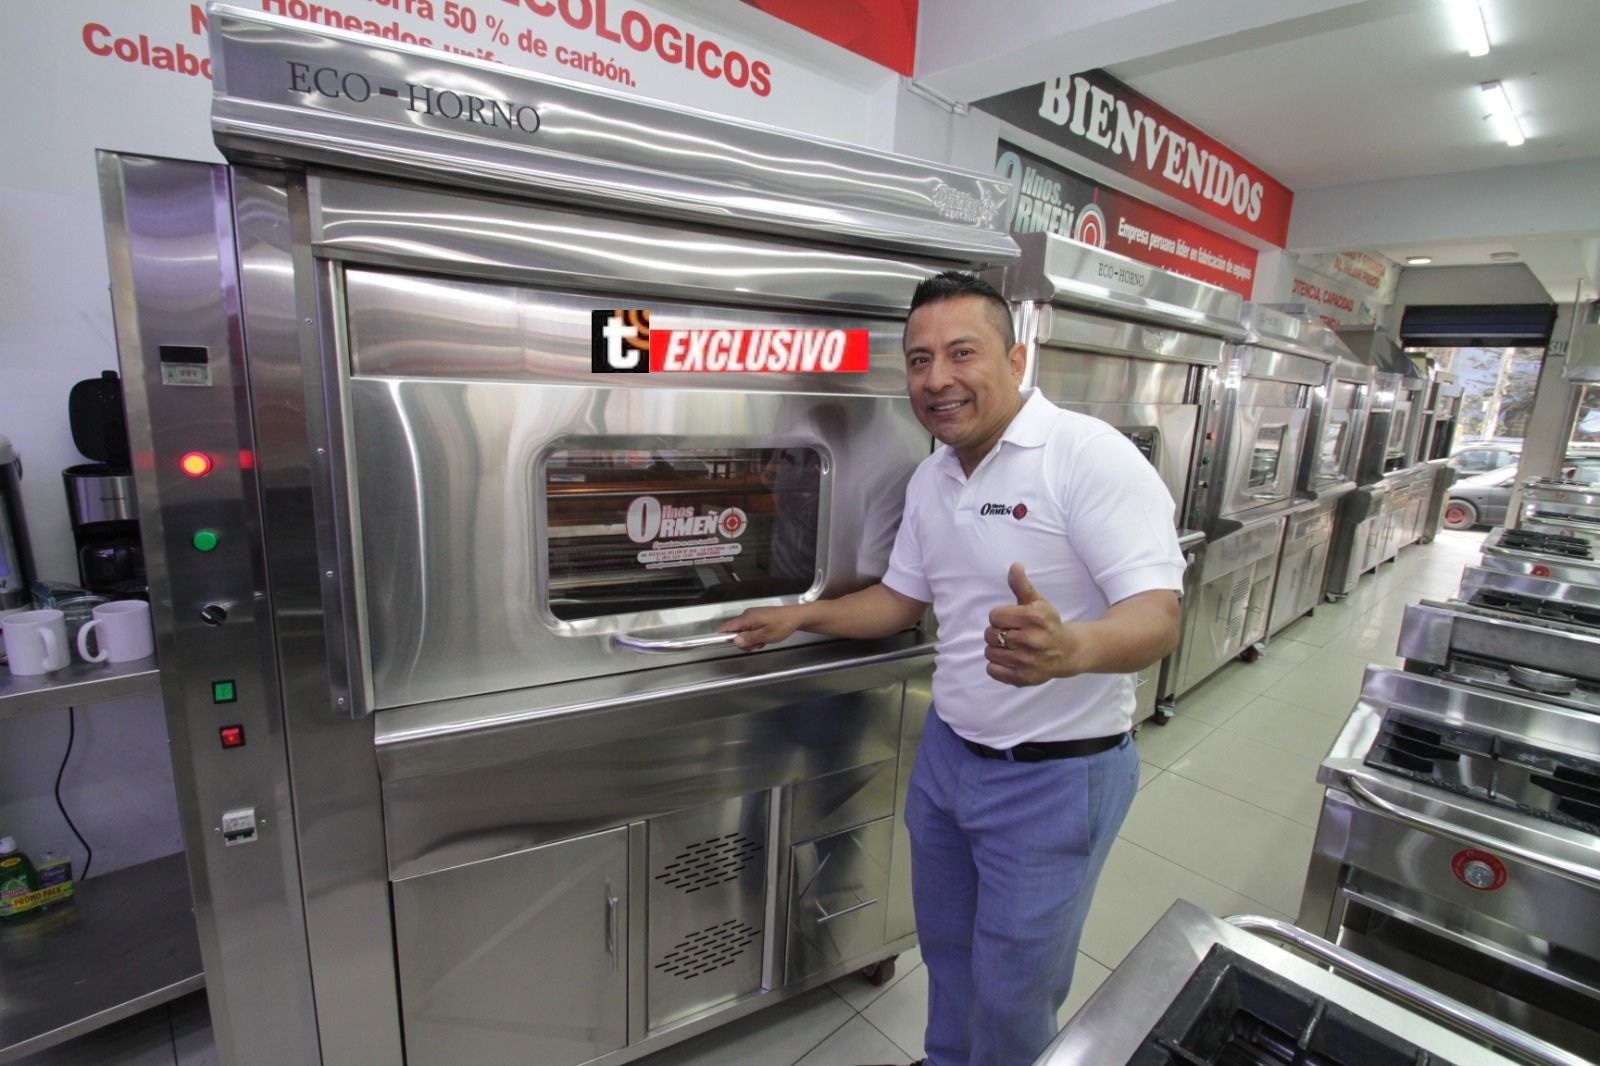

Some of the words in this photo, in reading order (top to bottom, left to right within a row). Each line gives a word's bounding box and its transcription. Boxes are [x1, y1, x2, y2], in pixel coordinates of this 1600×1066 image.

[443, 2, 477, 34] 50
[485, 15, 509, 46] %
[518, 28, 548, 57] de
[555, 45, 636, 87] carbón.
[502, 0, 771, 97] OLOGICOS
[1038, 74, 1264, 222] BIENVENIDOS
[1117, 217, 1149, 244] Empresa
[14, 892, 42, 906] PROMO
